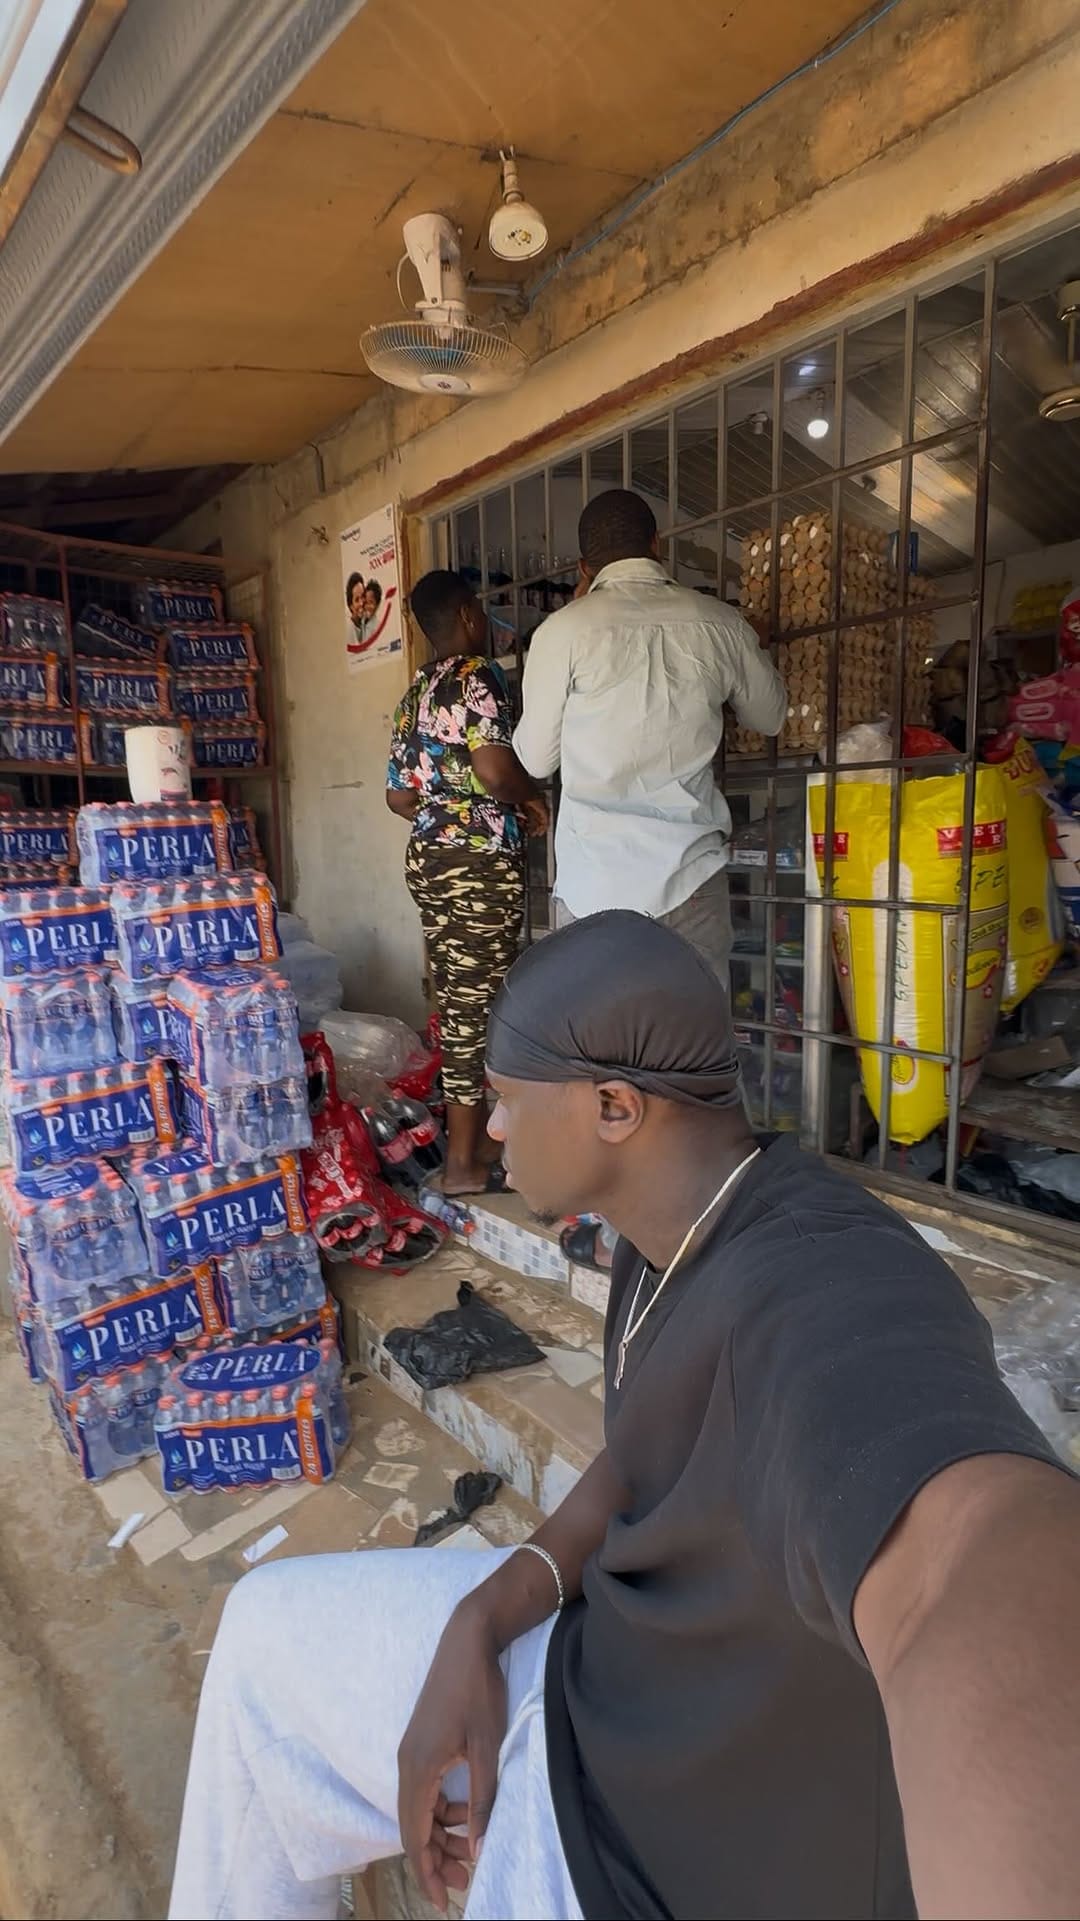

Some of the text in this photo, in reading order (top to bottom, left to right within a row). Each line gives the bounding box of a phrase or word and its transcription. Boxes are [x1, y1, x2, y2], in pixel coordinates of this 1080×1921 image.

[162, 599, 216, 618] PERLA
[190, 639, 248, 657] PERLA
[93, 678, 159, 699] PERLA
[194, 693, 249, 712] PERLA
[205, 743, 258, 762] PERLA
[2, 832, 69, 855] PERLA
[121, 833, 216, 868] PERLA
[153, 916, 260, 958] PERLA
[44, 1096, 154, 1147] PERLA
[180, 1190, 286, 1250] PERLA
[88, 1293, 202, 1361] PERLA
[211, 1350, 306, 1381] PERLA
[185, 1431, 300, 1470] PERLA
[302, 1418, 316, 1461] BOTTLES
